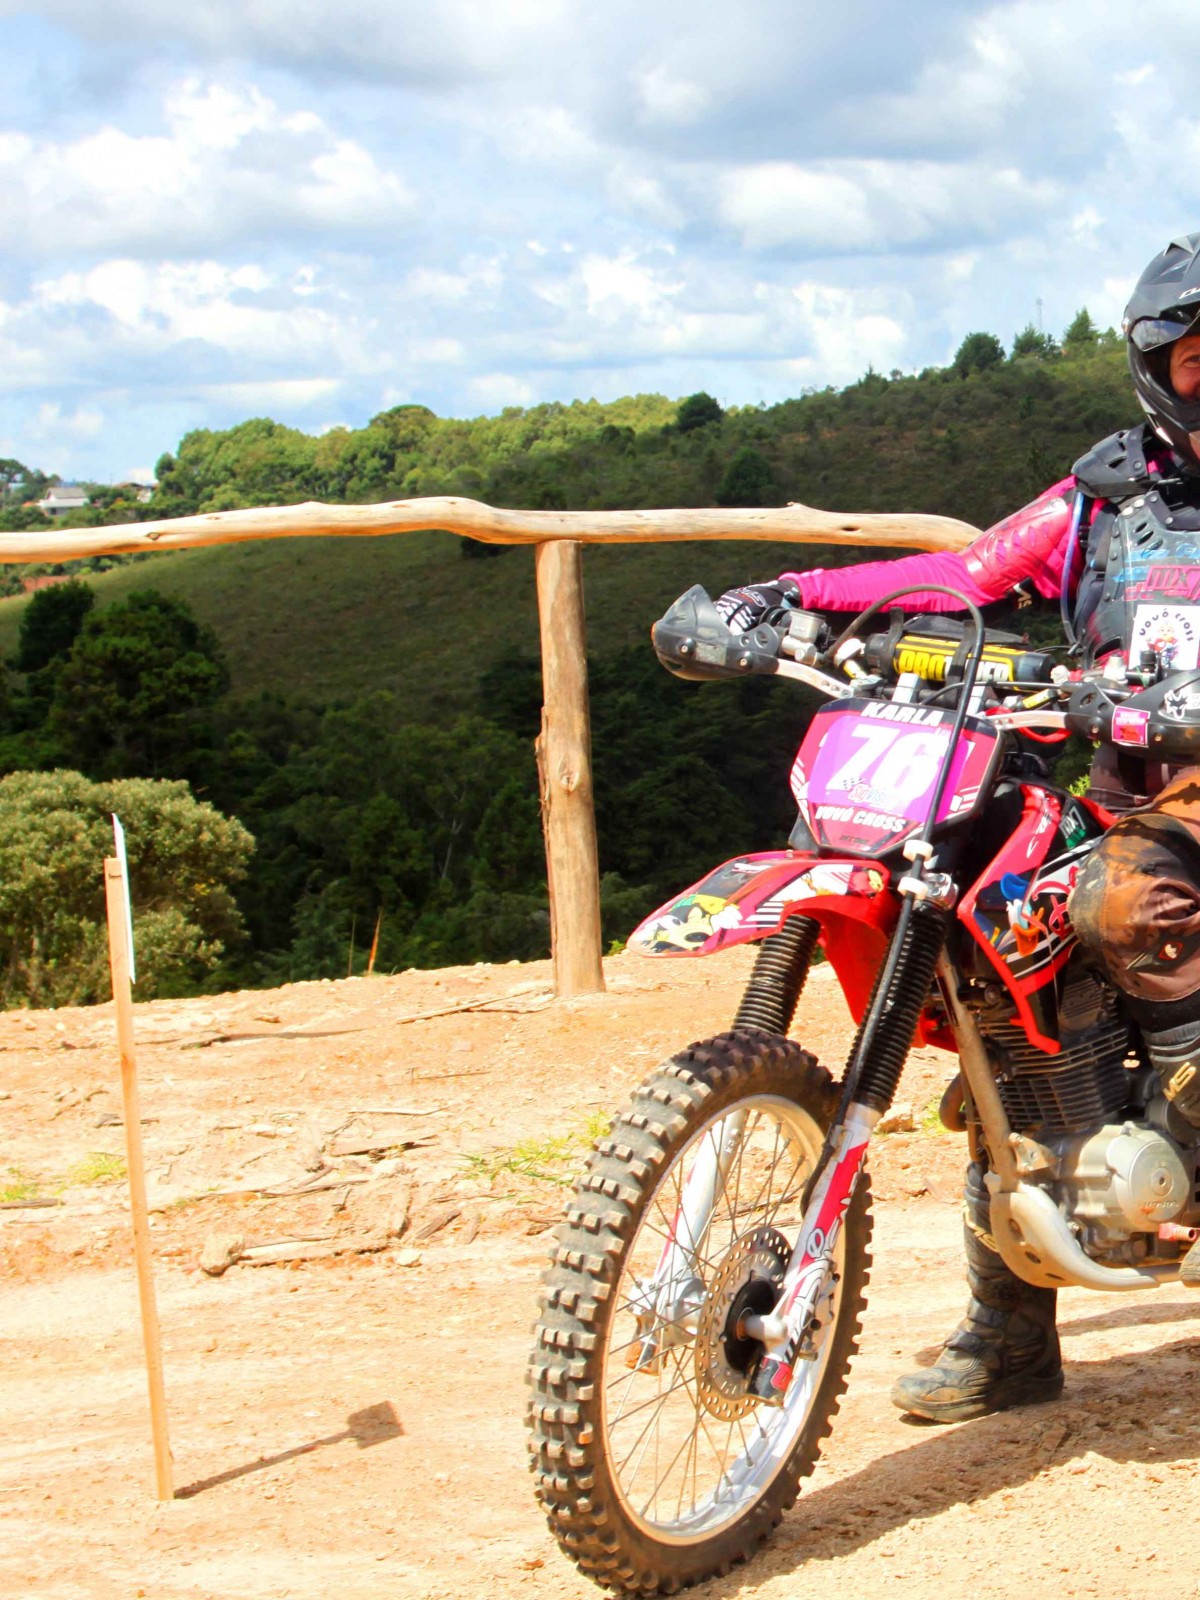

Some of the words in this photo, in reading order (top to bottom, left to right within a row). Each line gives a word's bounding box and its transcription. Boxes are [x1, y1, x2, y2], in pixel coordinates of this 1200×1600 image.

[860, 702, 945, 727] KARLA
[825, 724, 951, 807] 76
[852, 810, 907, 833] CROSS
